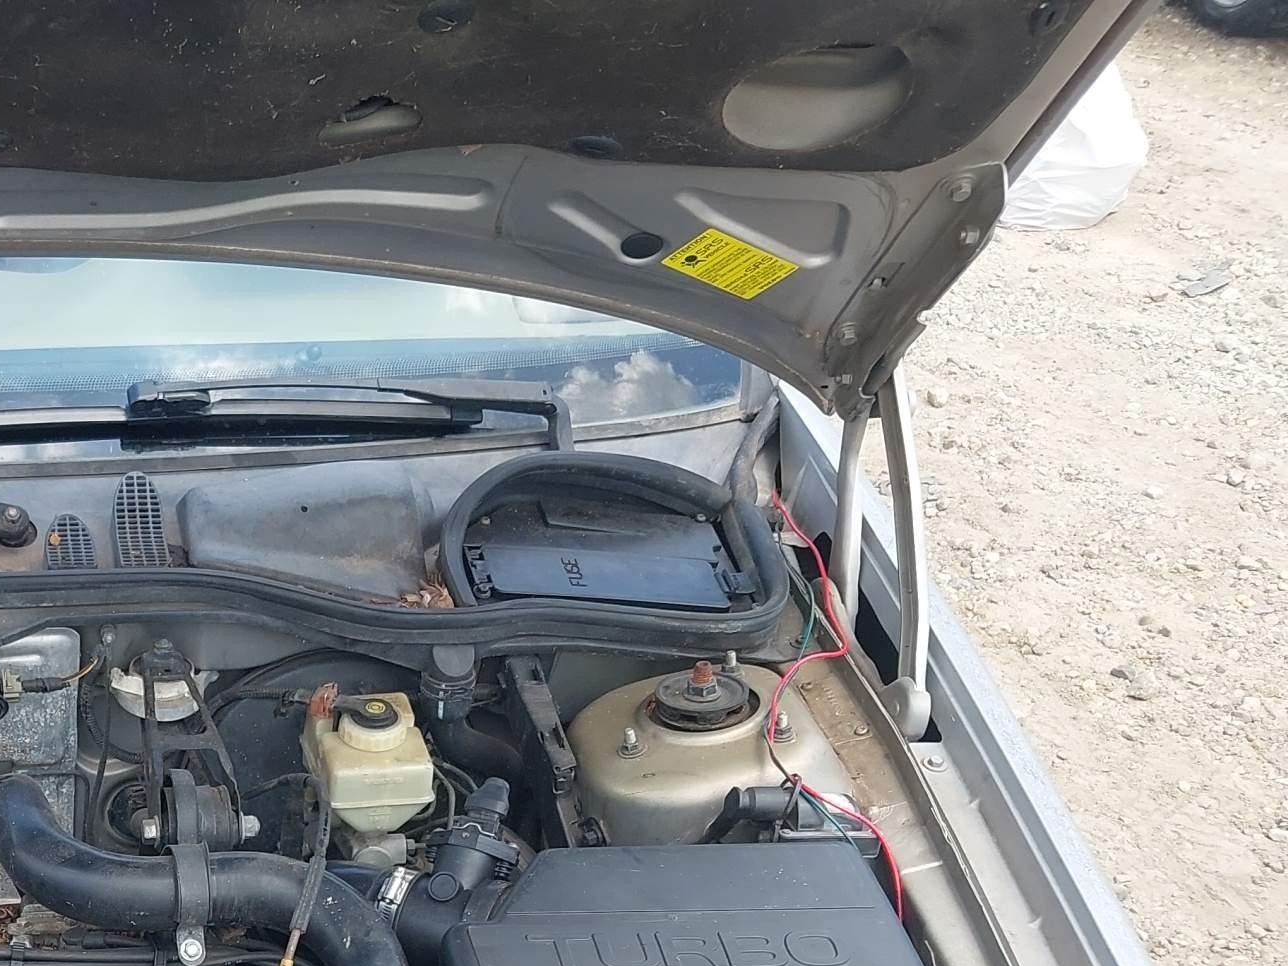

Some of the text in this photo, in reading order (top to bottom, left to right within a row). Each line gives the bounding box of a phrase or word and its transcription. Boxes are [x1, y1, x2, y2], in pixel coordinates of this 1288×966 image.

[695, 237, 724, 256] SRS
[744, 255, 773, 275] SRS
[561, 557, 588, 587] FUSE
